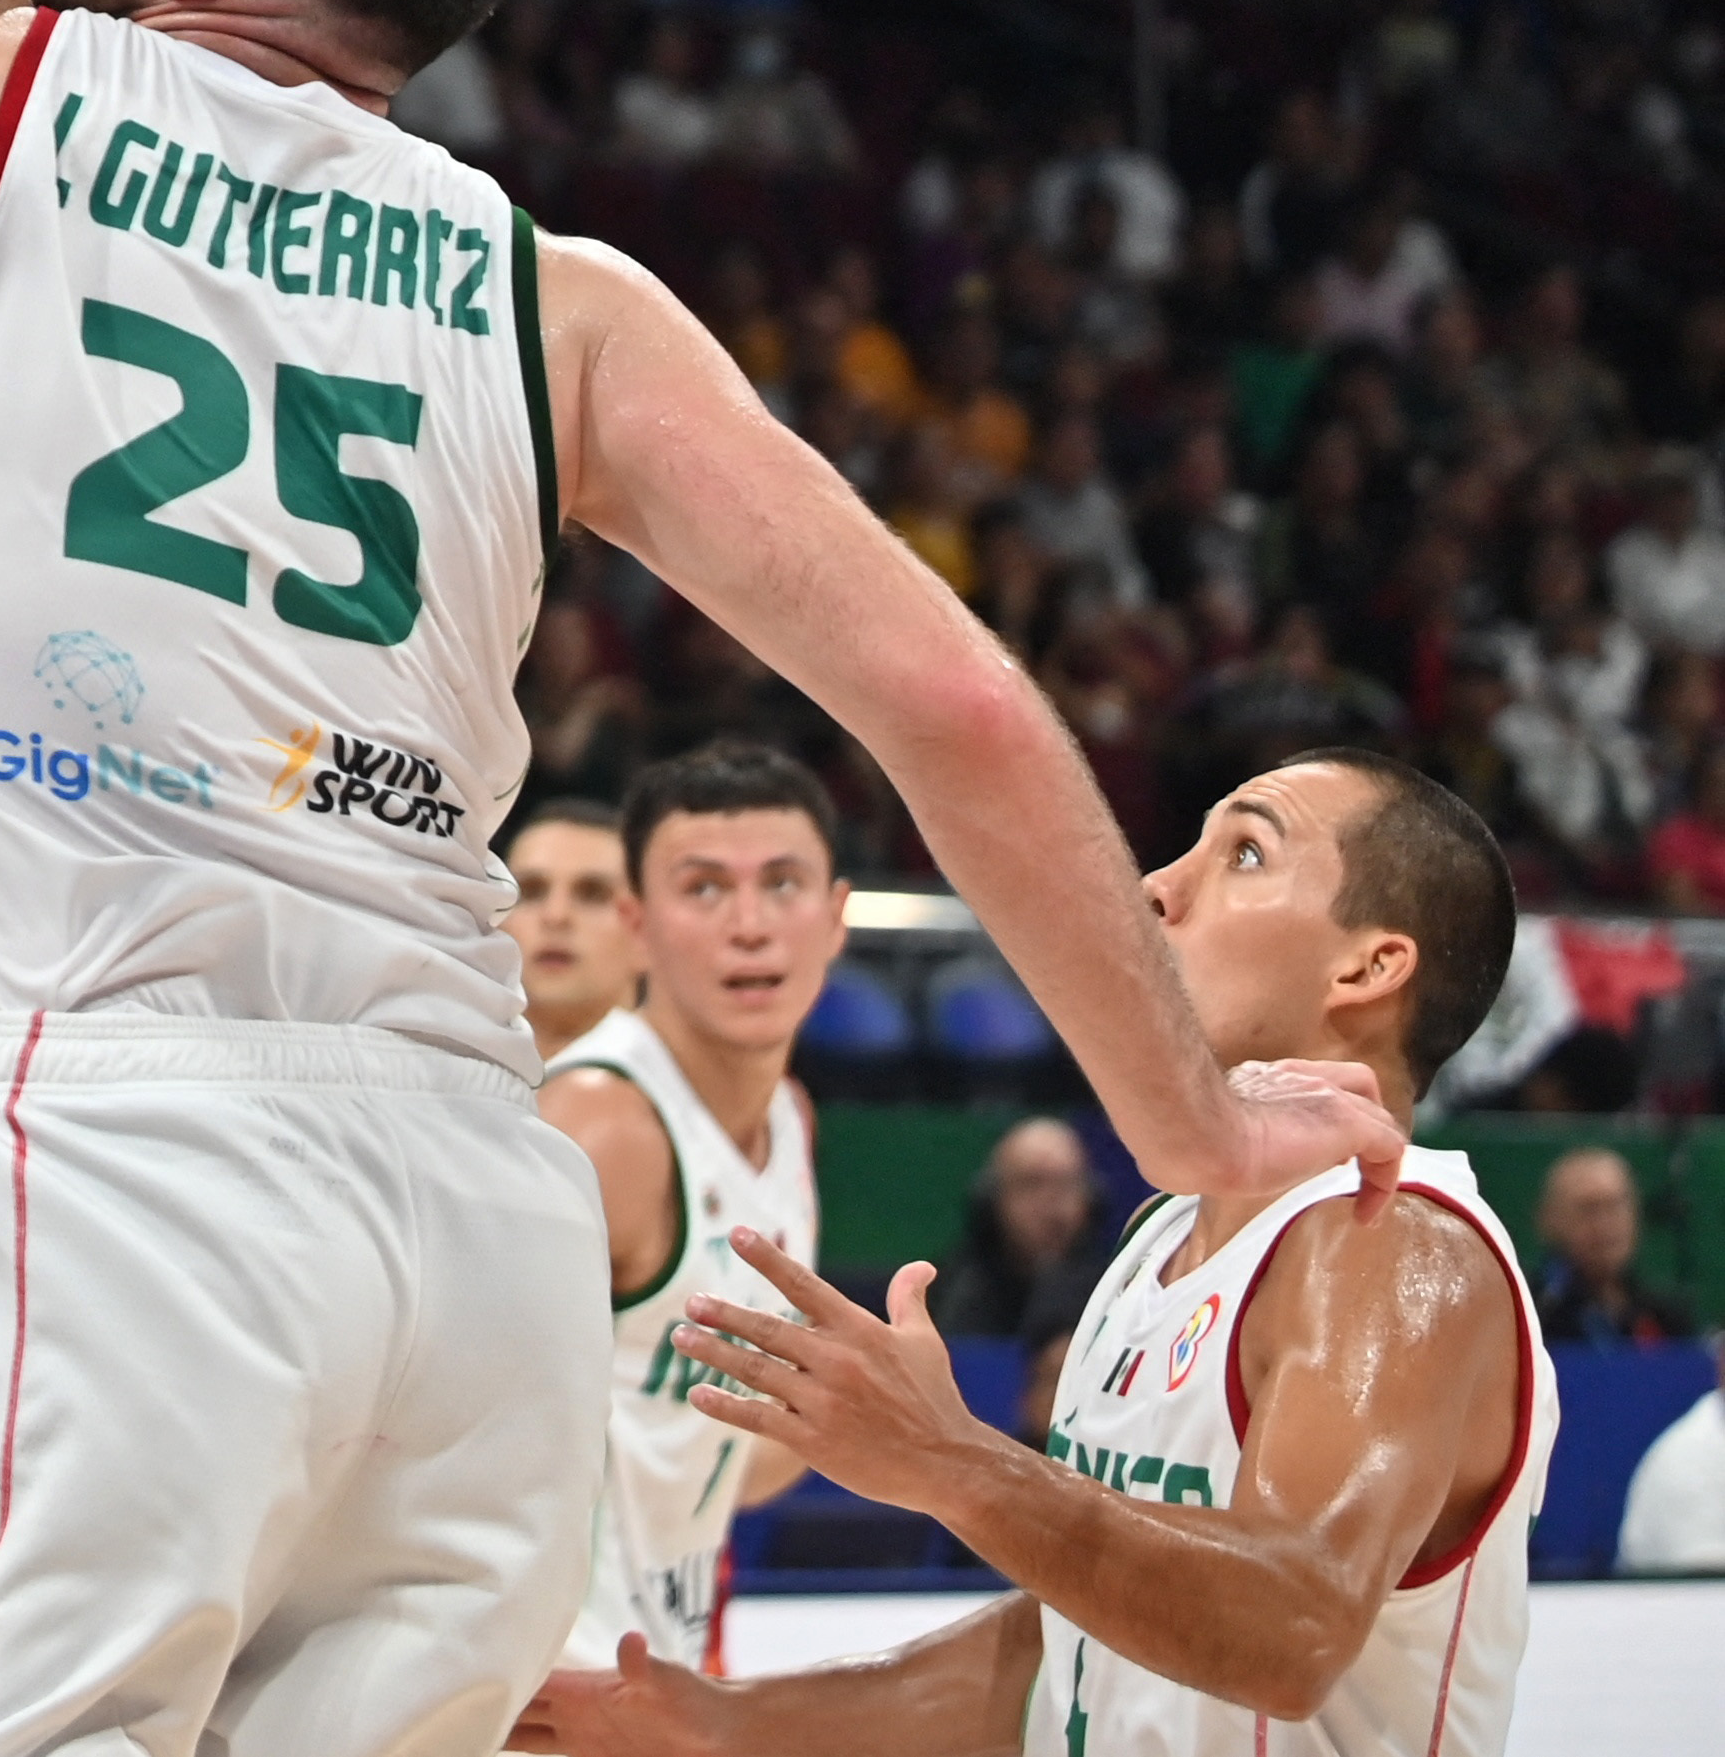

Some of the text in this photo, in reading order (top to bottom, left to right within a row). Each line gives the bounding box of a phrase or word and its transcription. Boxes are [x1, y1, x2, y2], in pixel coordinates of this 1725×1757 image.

[62, 296, 424, 648] 25
[333, 732, 442, 795] WIN
[306, 770, 466, 838] SPORT
